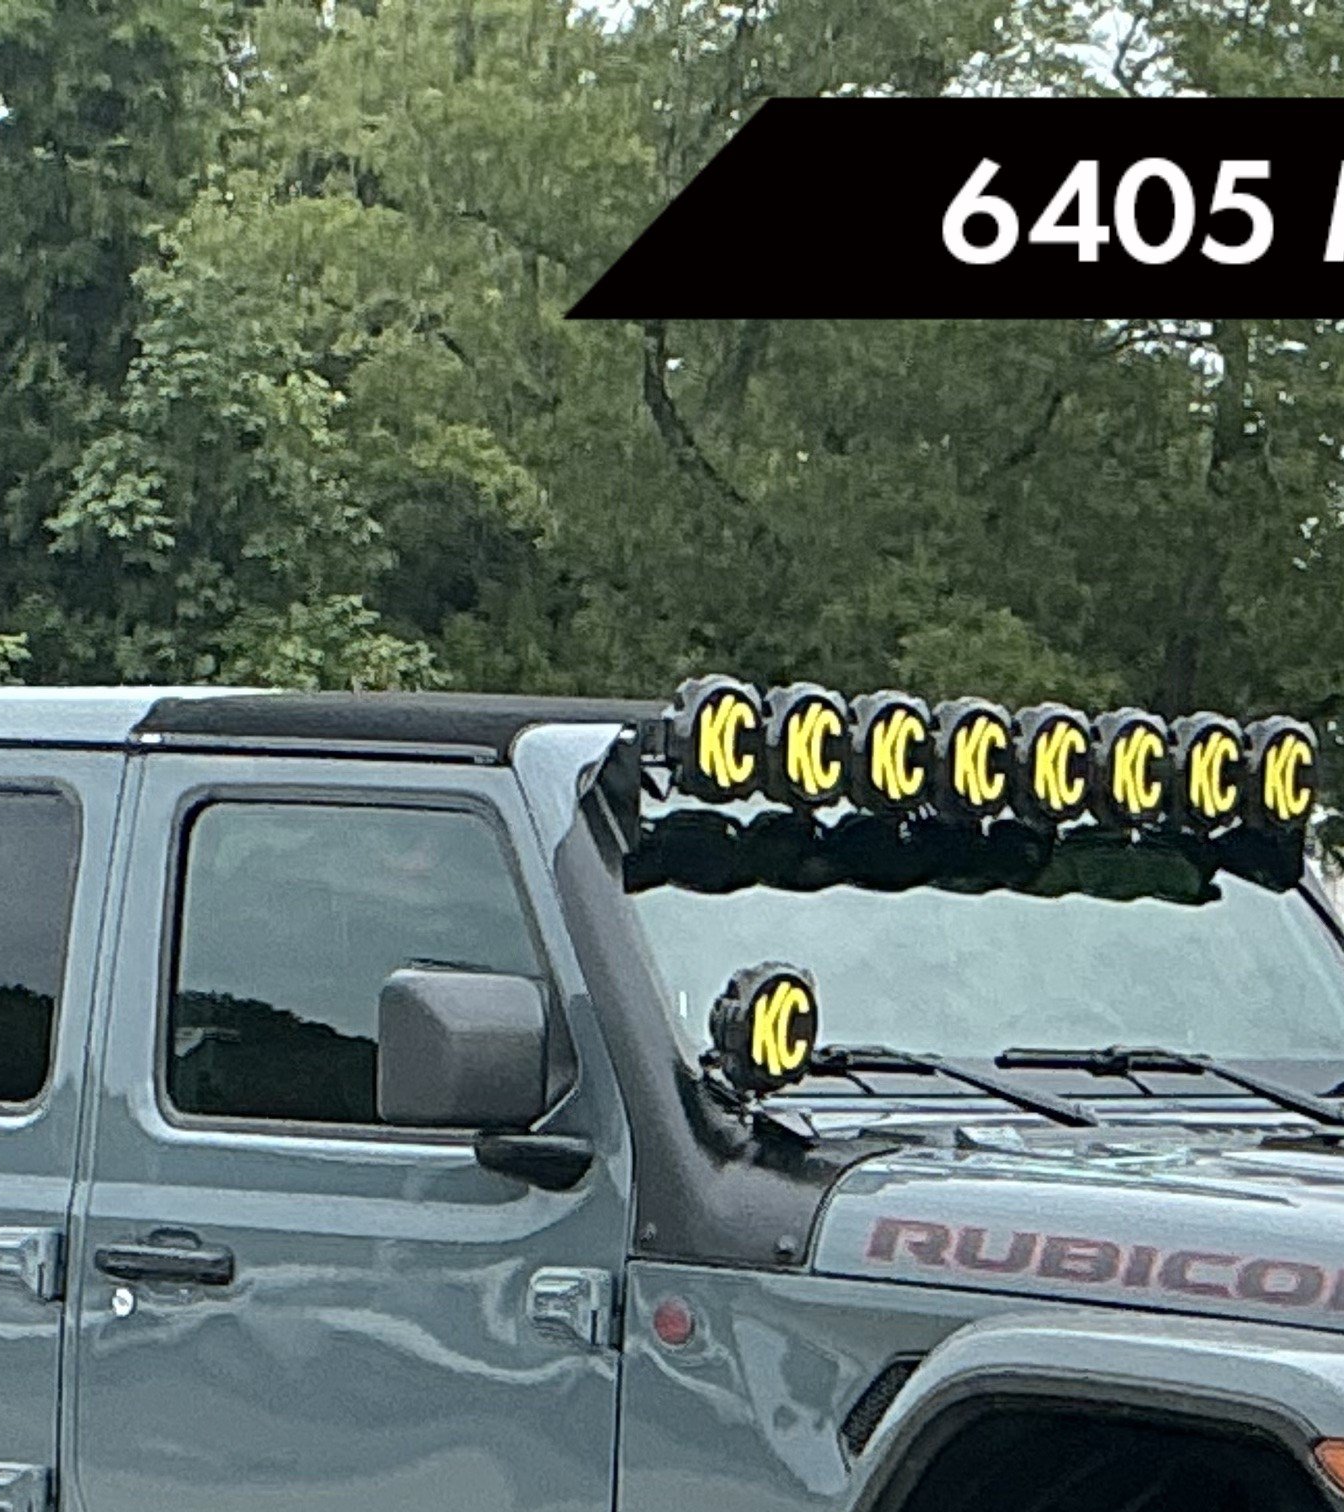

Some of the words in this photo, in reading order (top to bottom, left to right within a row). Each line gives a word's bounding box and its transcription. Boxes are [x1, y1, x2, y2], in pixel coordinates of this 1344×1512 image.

[698, 698, 755, 785] KC
[786, 706, 842, 792] KC
[870, 713, 926, 799] KC
[953, 720, 1008, 802] KC
[1033, 723, 1087, 806] KC
[1112, 729, 1164, 813] KC
[1189, 732, 1239, 816] KC
[1263, 736, 1313, 818] KC
[751, 982, 810, 1072] KC
